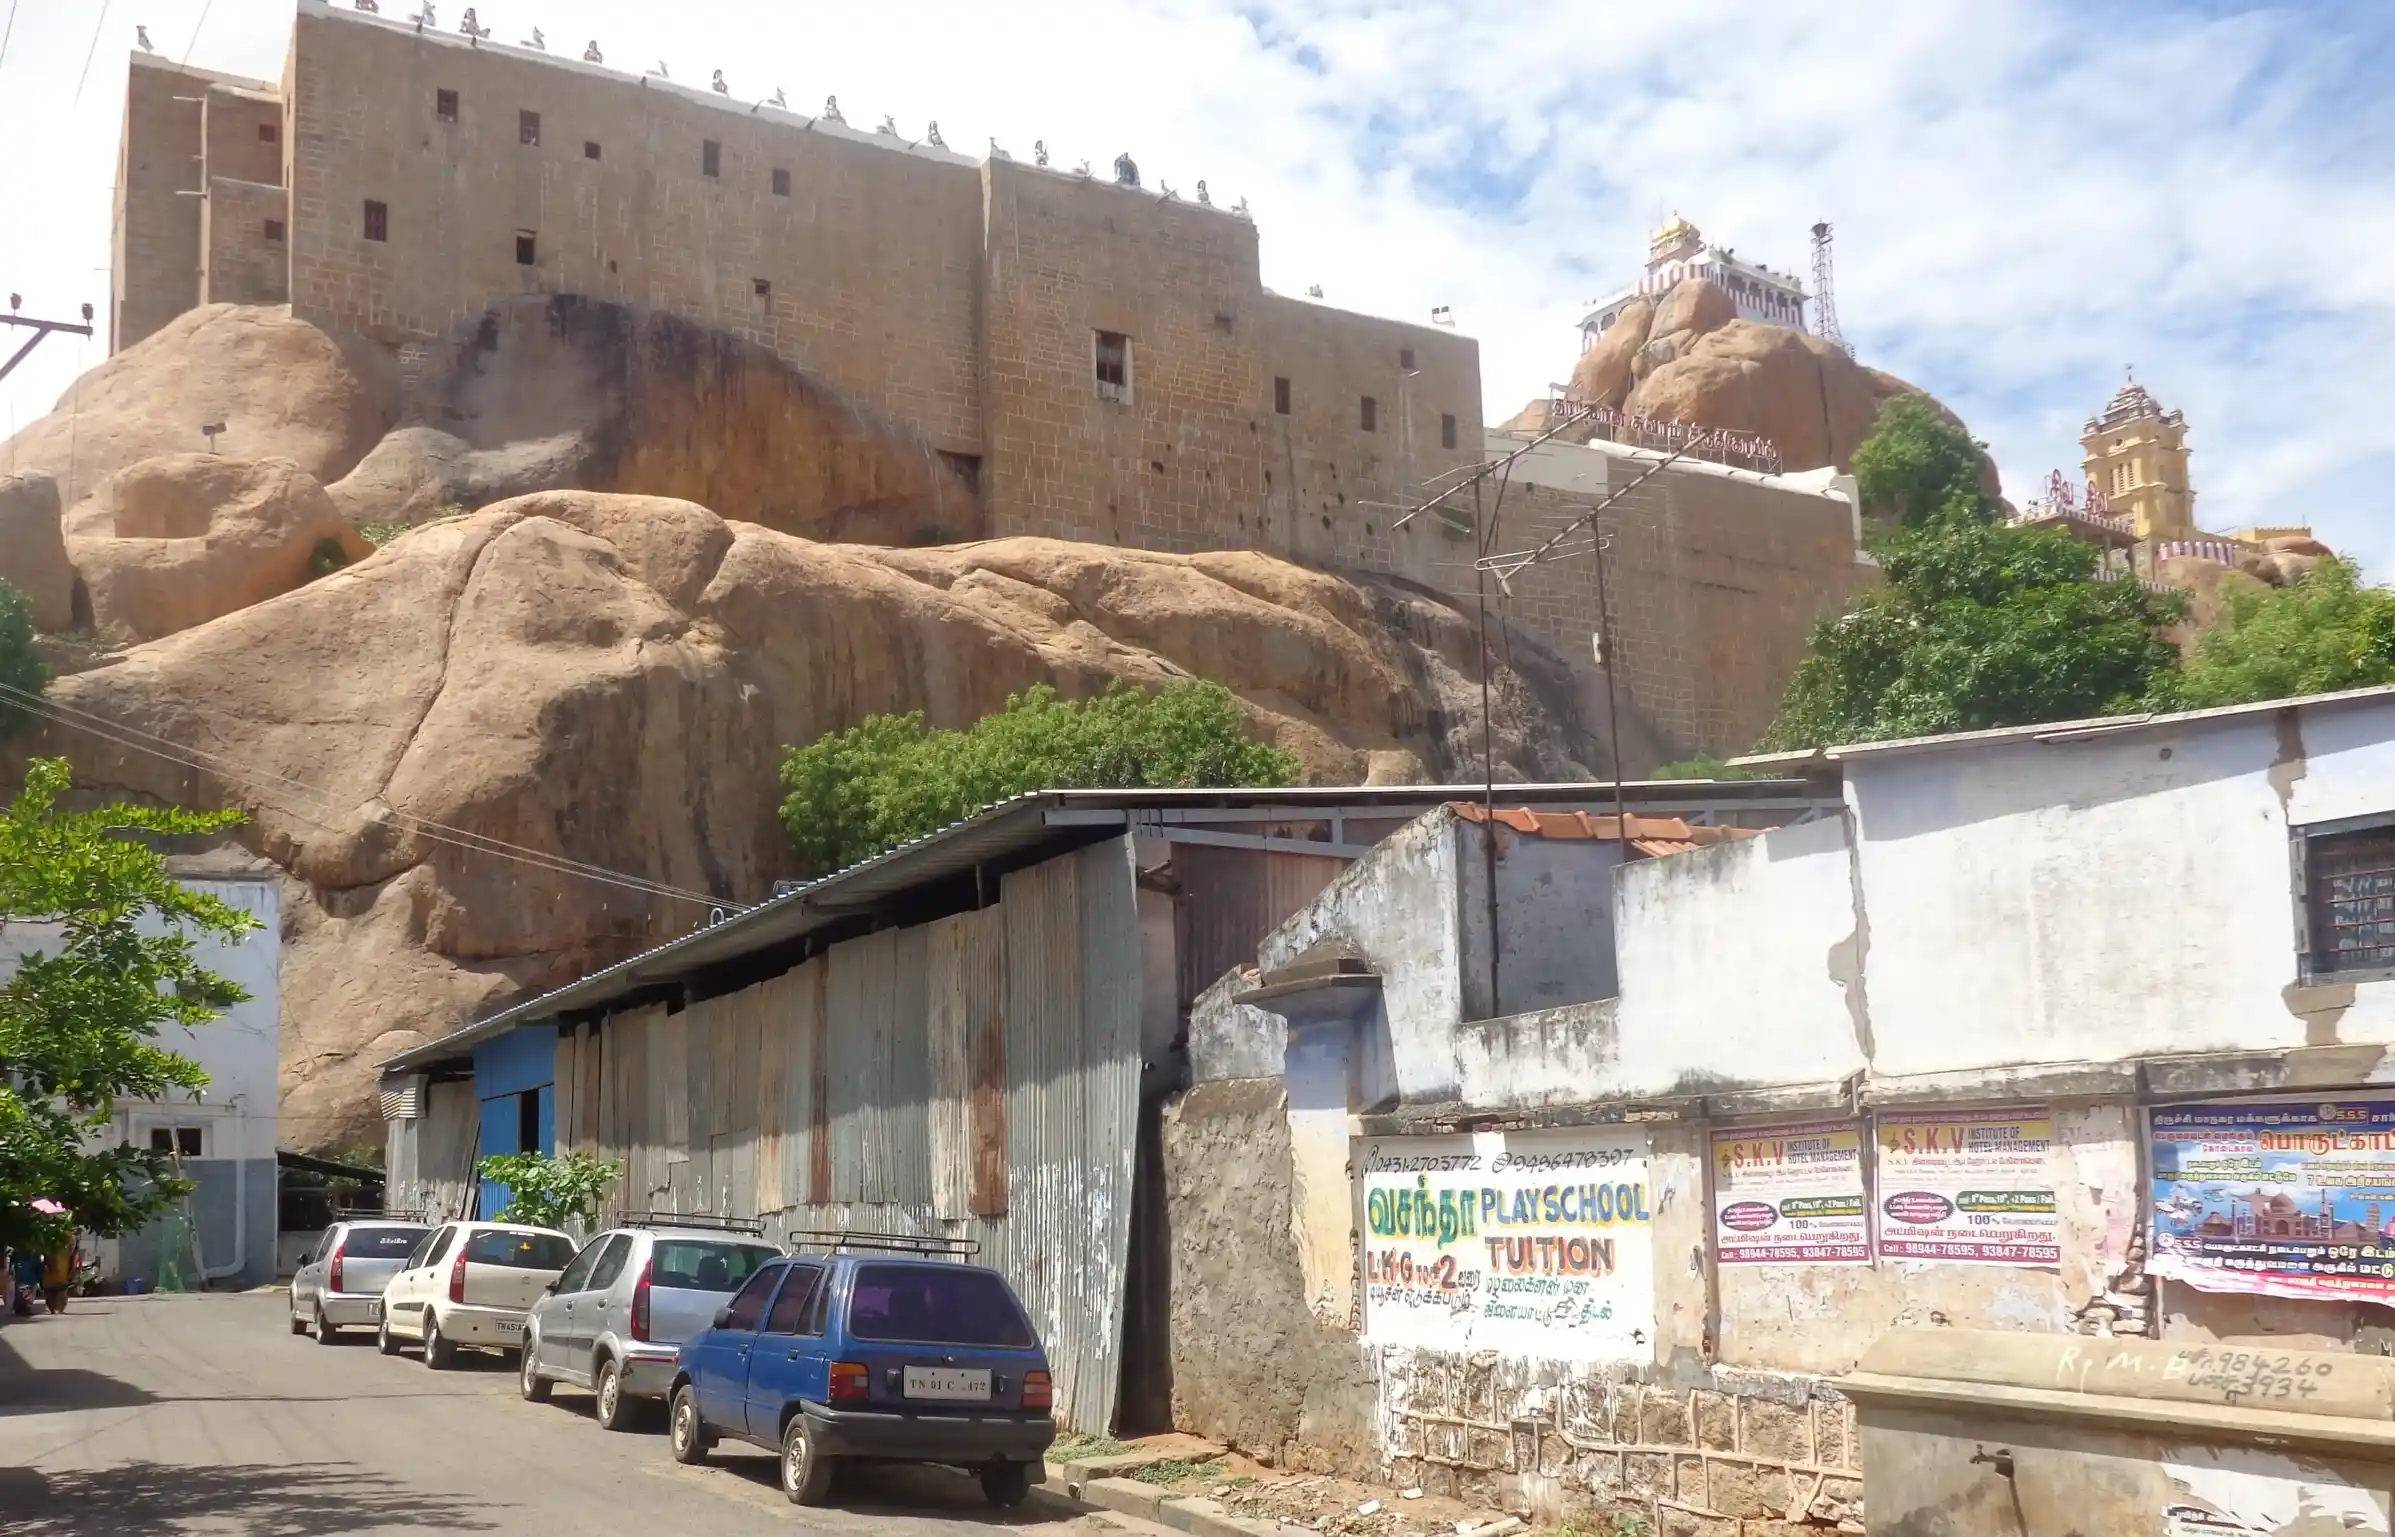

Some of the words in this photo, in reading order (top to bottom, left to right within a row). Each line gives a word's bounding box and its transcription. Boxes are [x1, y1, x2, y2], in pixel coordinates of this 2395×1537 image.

[1903, 1126, 1964, 1155] S.K.V
[1968, 1126, 2007, 1140] INSTITUTE
[2009, 1126, 2020, 1138] OF
[1787, 1138, 1820, 1152] INSTITUTE
[1821, 1137, 1831, 1149] OF
[1968, 1140, 1992, 1154] HOTEL
[1994, 1139, 2050, 1153] MANAGEMENT
[1734, 1140, 1784, 1168] S.K.V
[1788, 1153, 1809, 1165] HOTEL
[1810, 1149, 1857, 1163] MANAGEMENT
[1369, 1175, 1477, 1250] வசந்தா
[1485, 1236, 1615, 1276] TUITION
[1983, 1245, 2058, 1259] 93847-78595
[910, 1379, 925, 1390] TN
